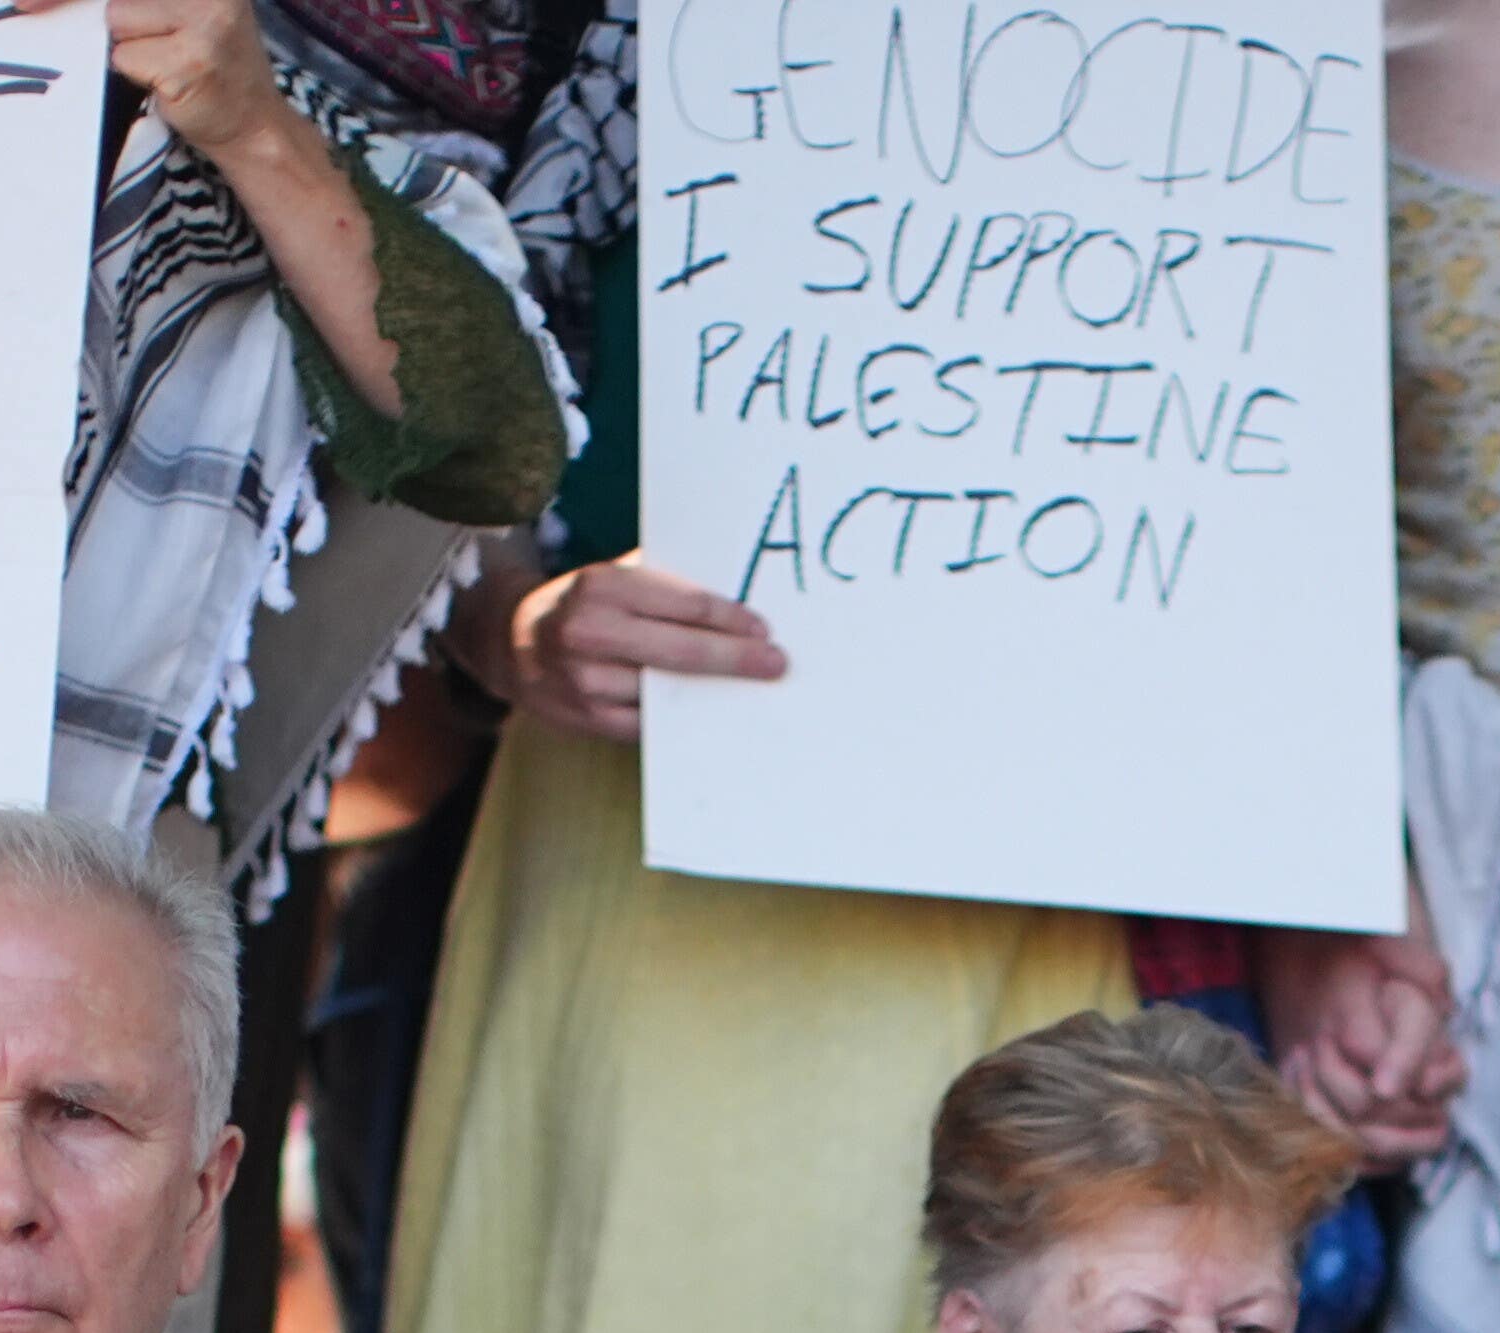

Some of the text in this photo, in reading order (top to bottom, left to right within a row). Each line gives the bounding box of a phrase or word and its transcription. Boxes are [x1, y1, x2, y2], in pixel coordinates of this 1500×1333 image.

[669, 0, 1361, 205] GENOCIDE
[658, 173, 1334, 353] I SUPPORT
[694, 322, 1298, 475] PALESTINE
[737, 464, 1195, 608] ACTION
